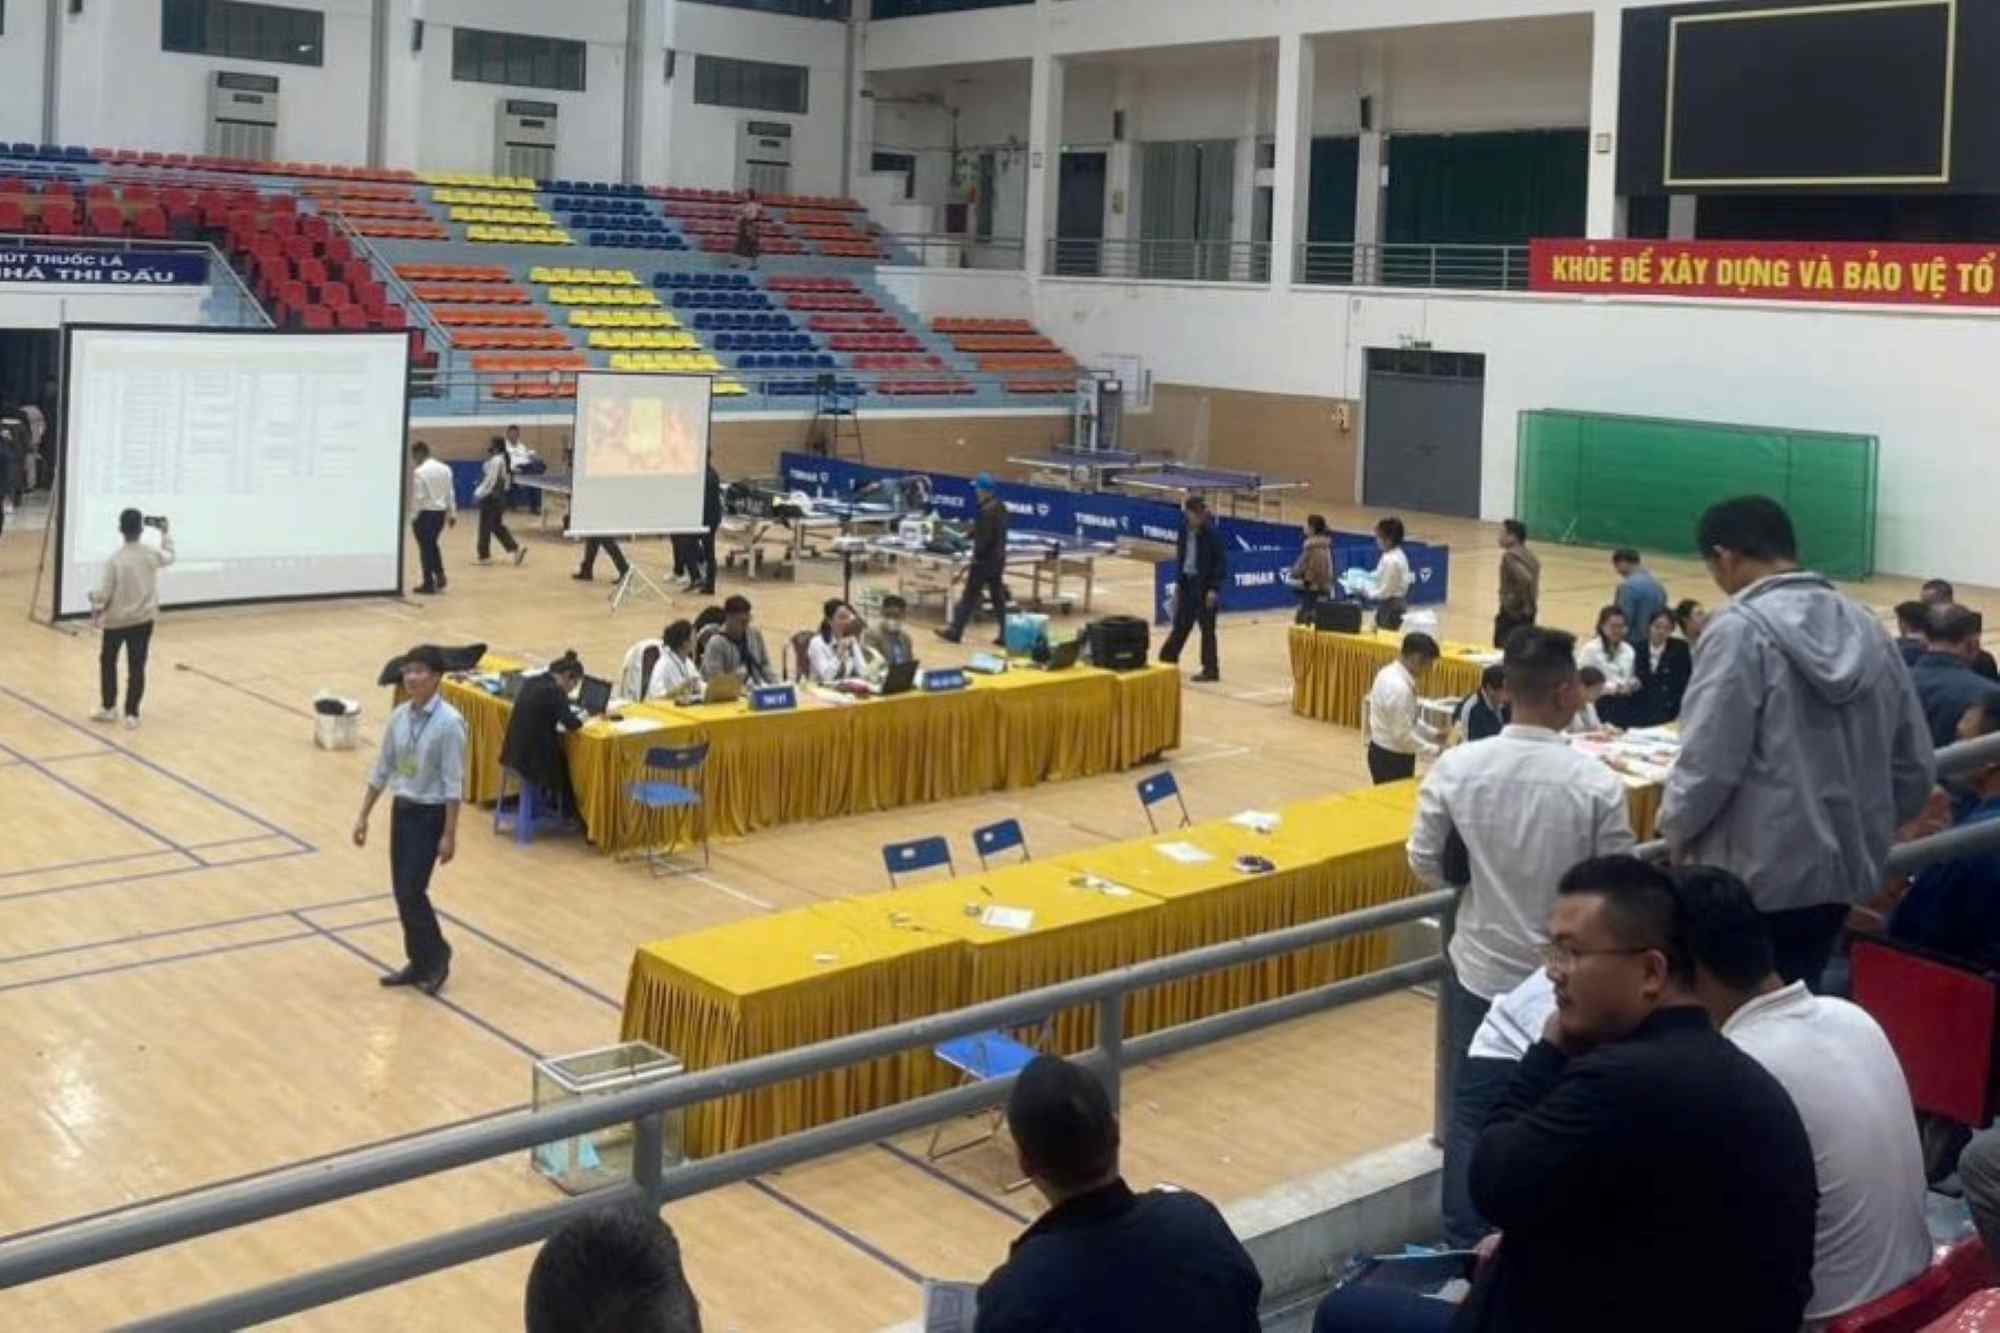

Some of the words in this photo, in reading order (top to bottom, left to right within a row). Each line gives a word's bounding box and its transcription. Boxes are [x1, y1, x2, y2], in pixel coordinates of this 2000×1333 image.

[55, 267, 102, 281] THI
[1552, 245, 1614, 282] KHỎE
[1659, 251, 1708, 285] XÂY
[1716, 254, 1789, 293] DỰNG
[1799, 254, 1834, 289] VÀ
[1843, 249, 1902, 291] BẢO
[1911, 256, 1947, 299] VỆ
[1956, 251, 1997, 294] TỔ
[1234, 572, 1274, 586] TIBHAR
